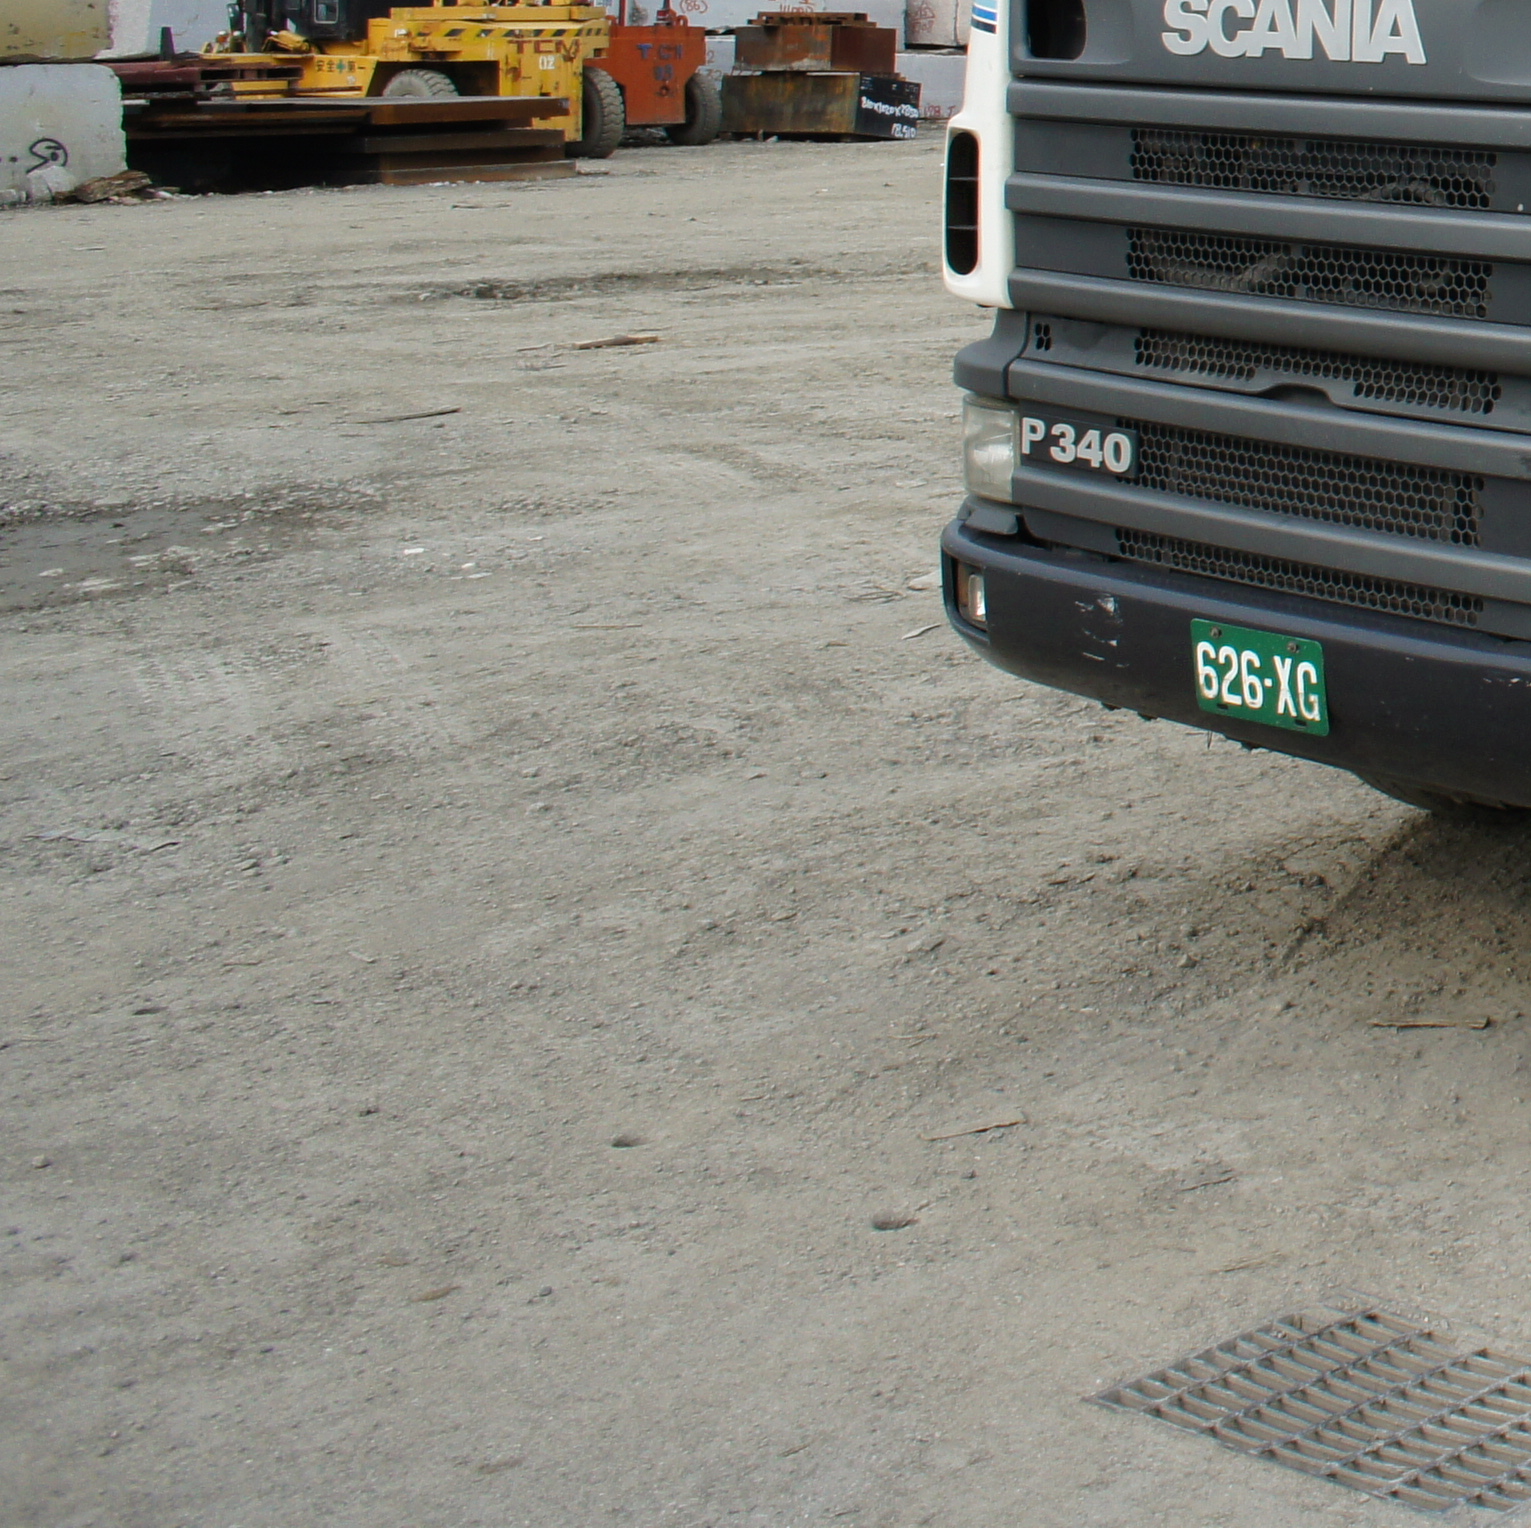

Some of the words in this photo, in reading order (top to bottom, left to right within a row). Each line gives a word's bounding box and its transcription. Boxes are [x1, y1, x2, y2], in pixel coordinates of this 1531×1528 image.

[507, 39, 581, 60] TCM
[539, 55, 556, 70] 02
[1021, 416, 1132, 473] P340
[1197, 641, 1321, 721] 626-XG
